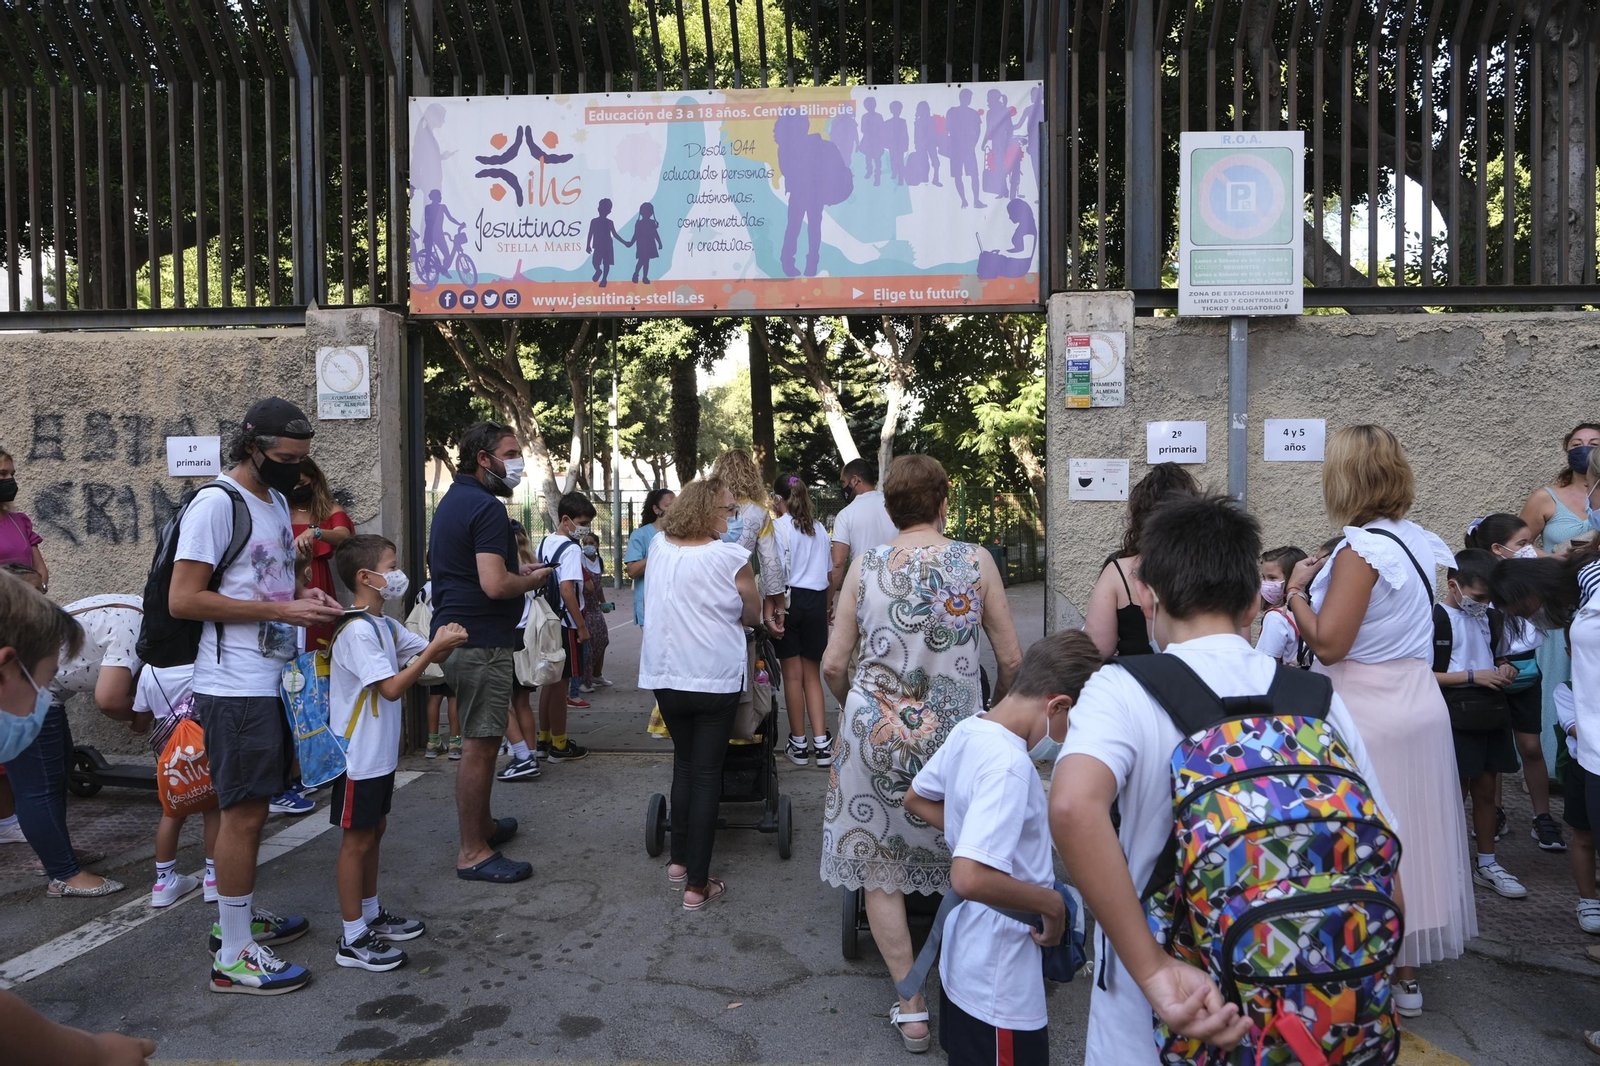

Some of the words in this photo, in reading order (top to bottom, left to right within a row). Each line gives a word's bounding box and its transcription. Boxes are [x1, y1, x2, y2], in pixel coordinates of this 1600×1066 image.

[589, 108, 657, 122] Educación
[658, 108, 674, 121] de
[676, 108, 684, 119] 3
[686, 110, 694, 119] a
[697, 107, 713, 119] 18
[716, 107, 750, 119] años.
[753, 105, 797, 118] Centro
[800, 104, 854, 119] Bilingüe
[1222, 134, 1262, 144] R.O.A.
[684, 142, 726, 158] Desde
[730, 139, 756, 156] 1944
[662, 165, 718, 181] educando
[721, 166, 775, 184] personas
[475, 207, 582, 252] Jesuitinas
[677, 212, 765, 233] comprometidas
[687, 240, 694, 257] y
[532, 291, 705, 308] www.jesuitinas-stella.es
[874, 288, 907, 303] Elige
[909, 289, 924, 300] tu
[926, 286, 969, 299] futuro
[1171, 430, 1182, 439] 2º
[1283, 428, 1289, 437] 4
[1291, 430, 1298, 439] y
[1299, 428, 1305, 437] 5
[1158, 444, 1197, 455] primaria
[1284, 442, 1306, 451] años
[176, 458, 211, 468] primaria
